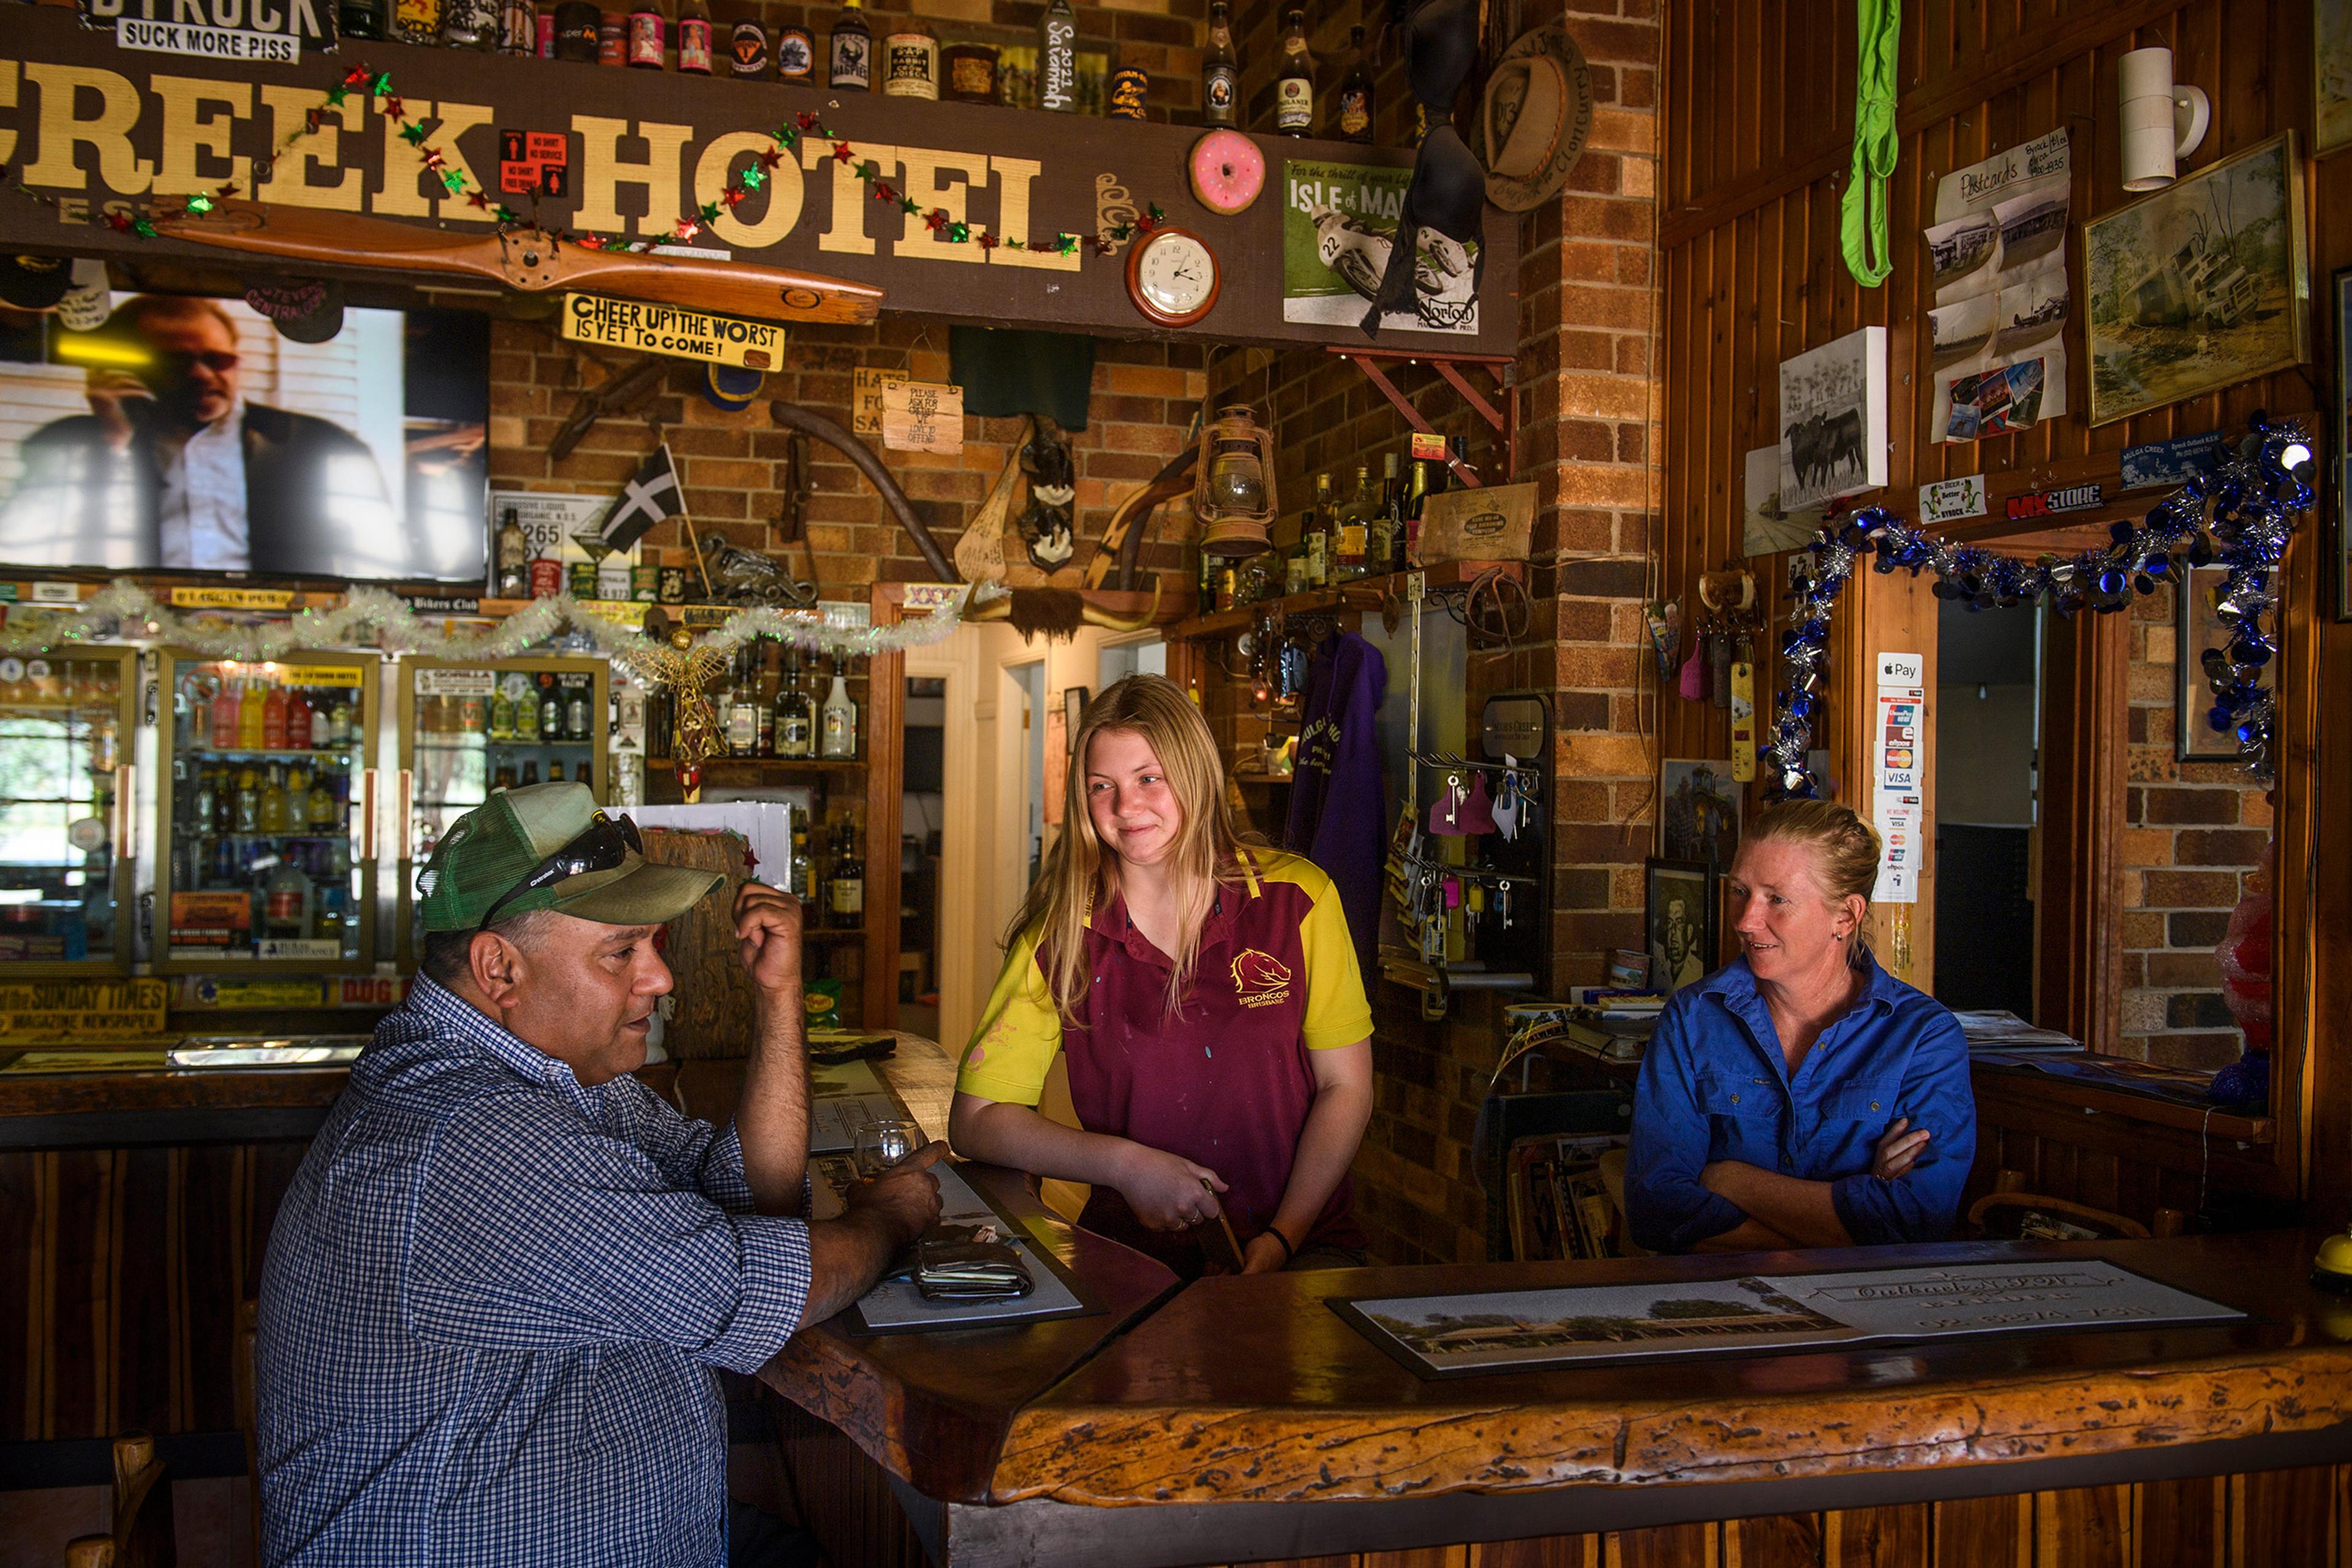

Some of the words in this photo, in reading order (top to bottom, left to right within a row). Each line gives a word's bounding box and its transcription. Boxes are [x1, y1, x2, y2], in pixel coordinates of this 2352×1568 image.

[126, 23, 179, 48] SUCK
[187, 30, 243, 55] MORE
[249, 37, 292, 60] PISS
[0, 60, 500, 223] REEK
[571, 114, 1082, 272] HOTEL
[1291, 164, 1306, 176] For
[1308, 165, 1325, 178] the
[1327, 167, 1355, 180] thrill
[1398, 172, 1414, 183] Lif
[1961, 157, 2018, 200] Postcards
[1291, 179, 1343, 214] ISLE
[1322, 236, 1340, 257] 22
[1416, 297, 1476, 326] Norton
[571, 296, 641, 327] CHEER
[679, 313, 707, 336] THE
[712, 318, 777, 347] WORST
[575, 318, 594, 337] IS
[595, 322, 629, 342] YET
[635, 327, 657, 347] TO
[856, 370, 907, 388] HATS
[863, 395, 884, 410] FO
[908, 398, 922, 409] ASK
[924, 399, 938, 410] FOR
[855, 415, 881, 431] SA
[928, 425, 937, 434] TO
[2123, 449, 2143, 461] MULGA
[2144, 445, 2165, 454] CREEK
[1941, 508, 1964, 518] BYROCK
[523, 524, 560, 543] 265
[452, 597, 478, 610] Club
[1895, 663, 1916, 679] Pay
[1889, 709, 1912, 717] UnionPay
[1888, 772, 1911, 783] VISA
[32, 983, 98, 1010] SUNDAY
[107, 984, 162, 1009] TIMES
[1239, 990, 1289, 1005] BRONCOS
[1248, 998, 1284, 1009] BRISBANE
[13, 1014, 78, 1030] MAGAZINE
[81, 1014, 157, 1031] NEWSPAPER
